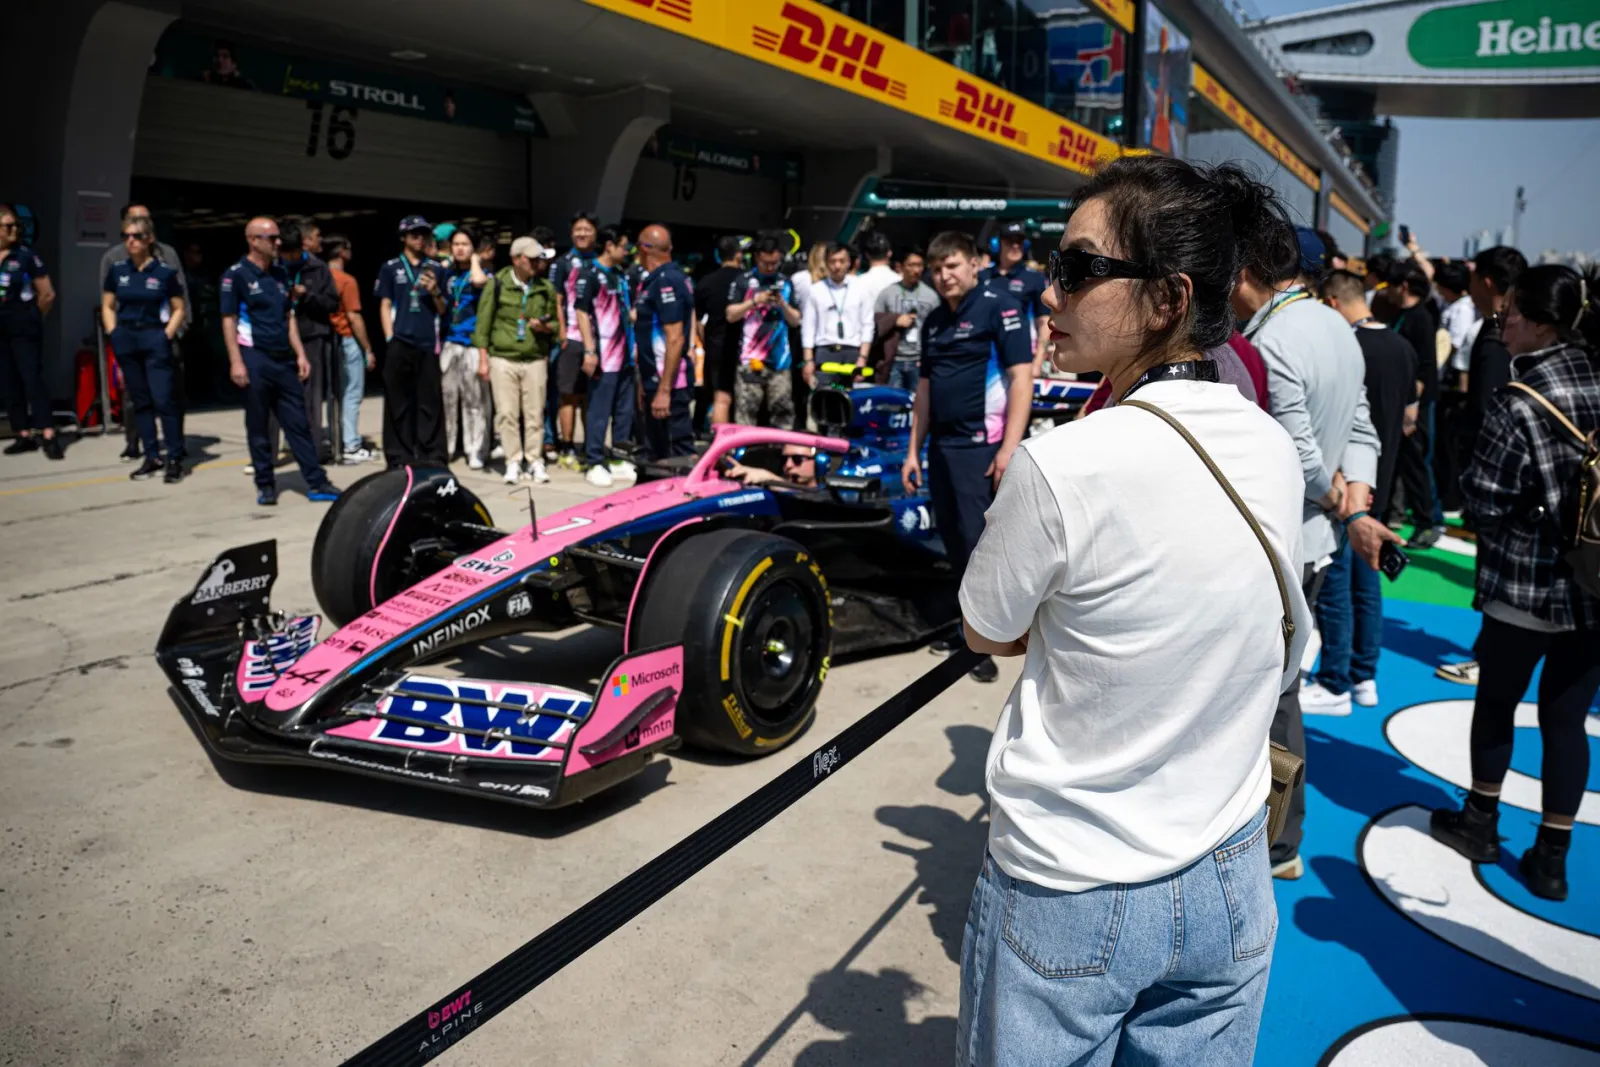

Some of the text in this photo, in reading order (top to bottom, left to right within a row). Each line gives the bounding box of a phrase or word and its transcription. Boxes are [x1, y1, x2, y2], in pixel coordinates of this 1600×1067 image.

[779, 2, 890, 93] DHL
[1475, 16, 1600, 57] Heine
[328, 79, 426, 112] STROLL
[954, 80, 1016, 140] DHL
[307, 101, 358, 159] 16
[887, 199, 919, 210] ASTON
[919, 199, 957, 210] MARTIN
[459, 558, 511, 576] BWT
[508, 596, 532, 615] FIA
[412, 604, 492, 658] INFINOX
[631, 662, 680, 687] Microsoft
[643, 718, 674, 739] mntn
[441, 990, 472, 1022] BWT
[418, 1001, 484, 1053] ALPINE
